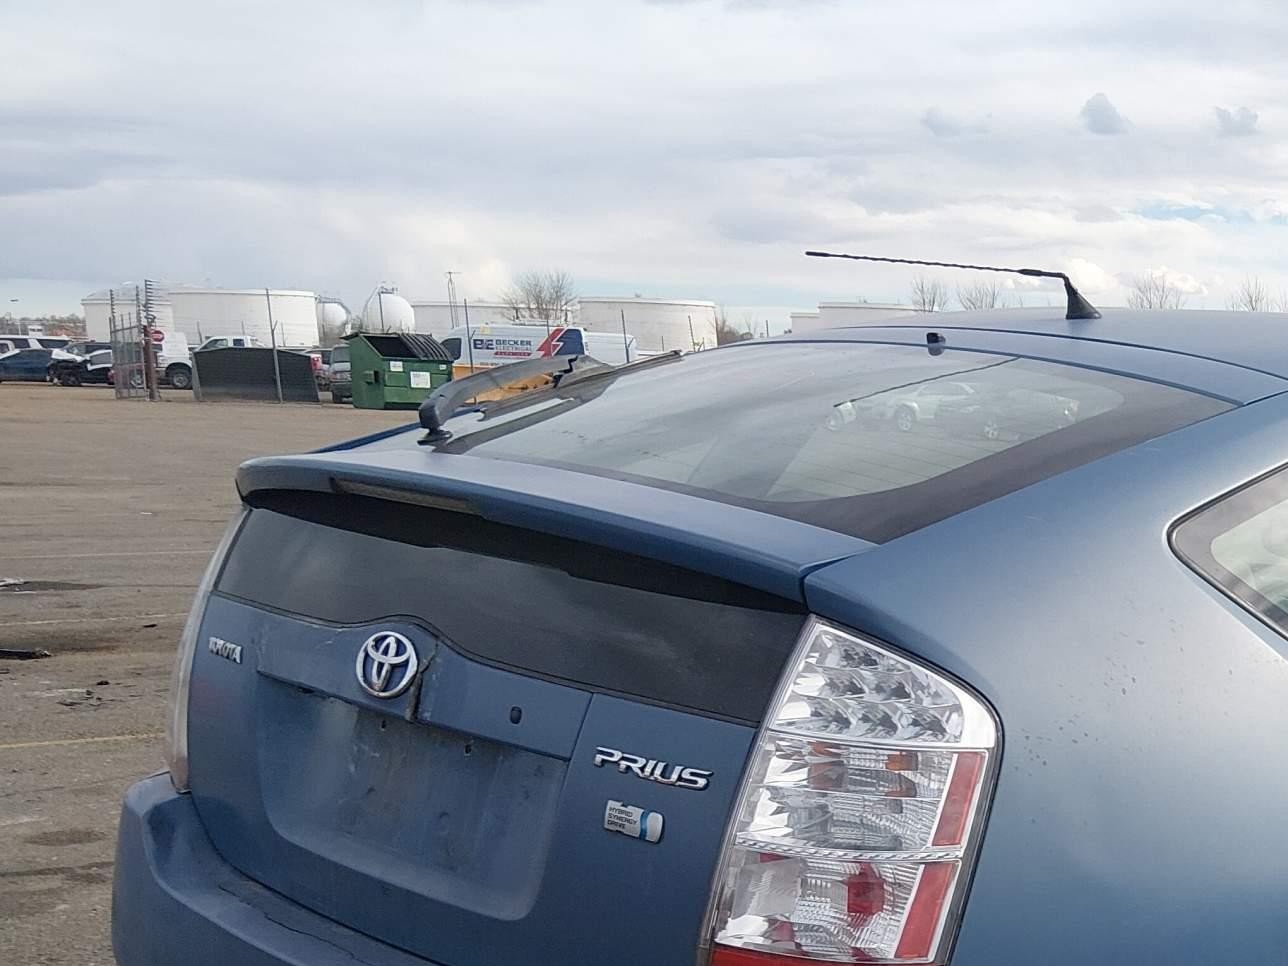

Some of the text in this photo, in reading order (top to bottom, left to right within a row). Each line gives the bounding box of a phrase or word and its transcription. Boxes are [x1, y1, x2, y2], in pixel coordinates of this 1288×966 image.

[593, 746, 714, 789] PRIUS
[608, 806, 634, 818] HYBRID
[606, 819, 627, 829] DRIVE
[607, 812, 638, 825] SYNERGY
